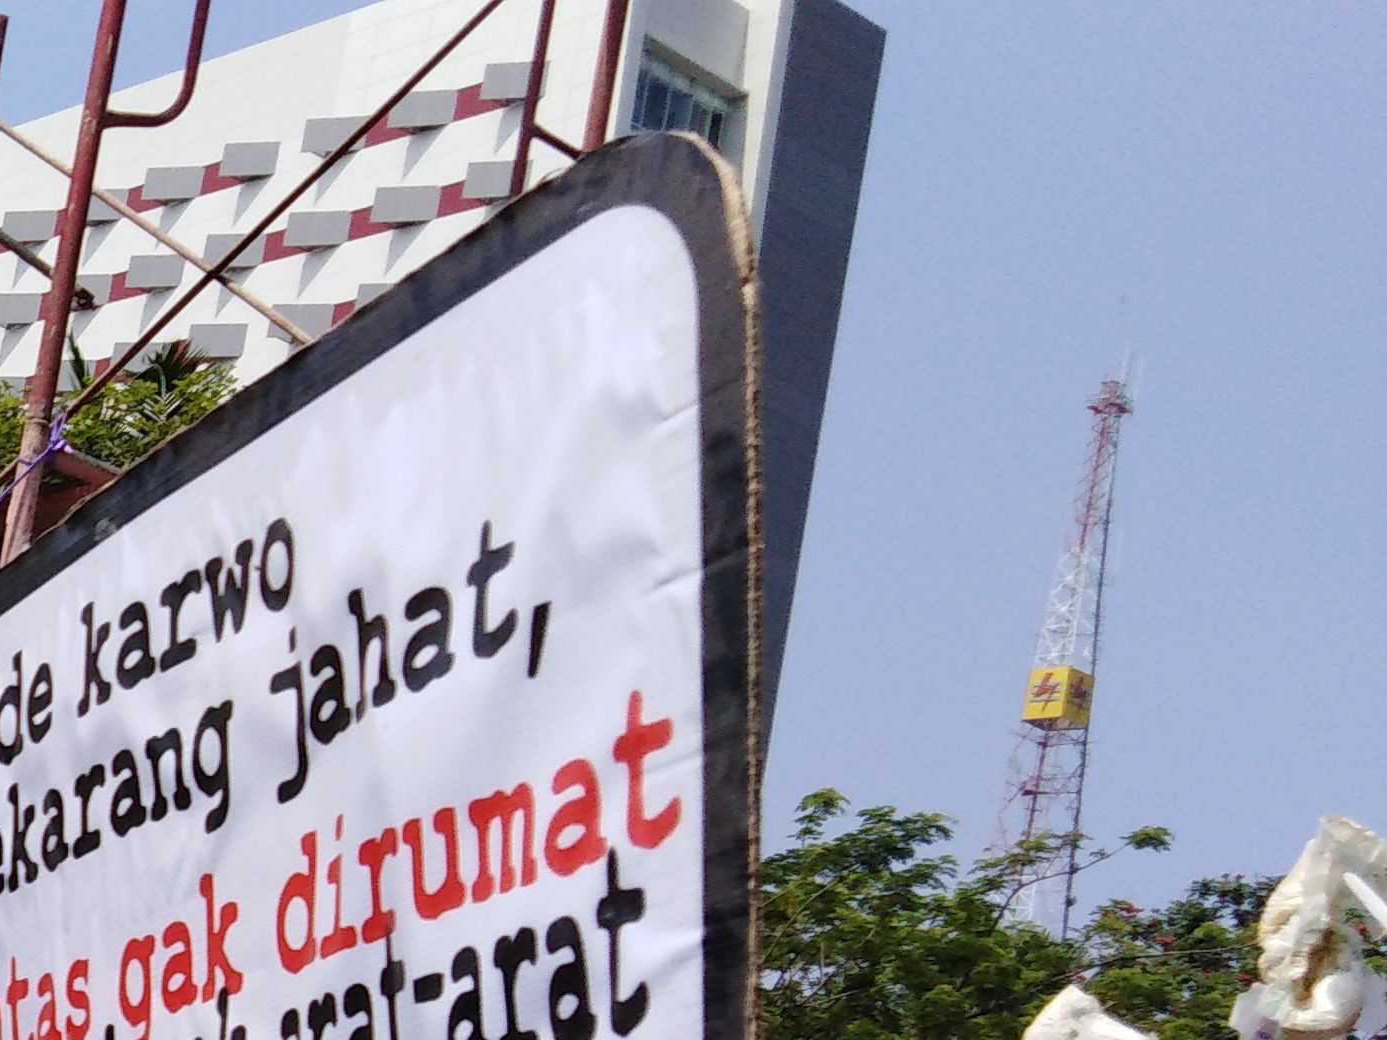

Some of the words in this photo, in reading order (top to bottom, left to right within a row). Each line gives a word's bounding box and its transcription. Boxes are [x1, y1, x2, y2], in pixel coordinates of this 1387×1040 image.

[76, 517, 294, 718] karwo
[269, 519, 551, 804] jahat,
[275, 689, 682, 975] dirumat
